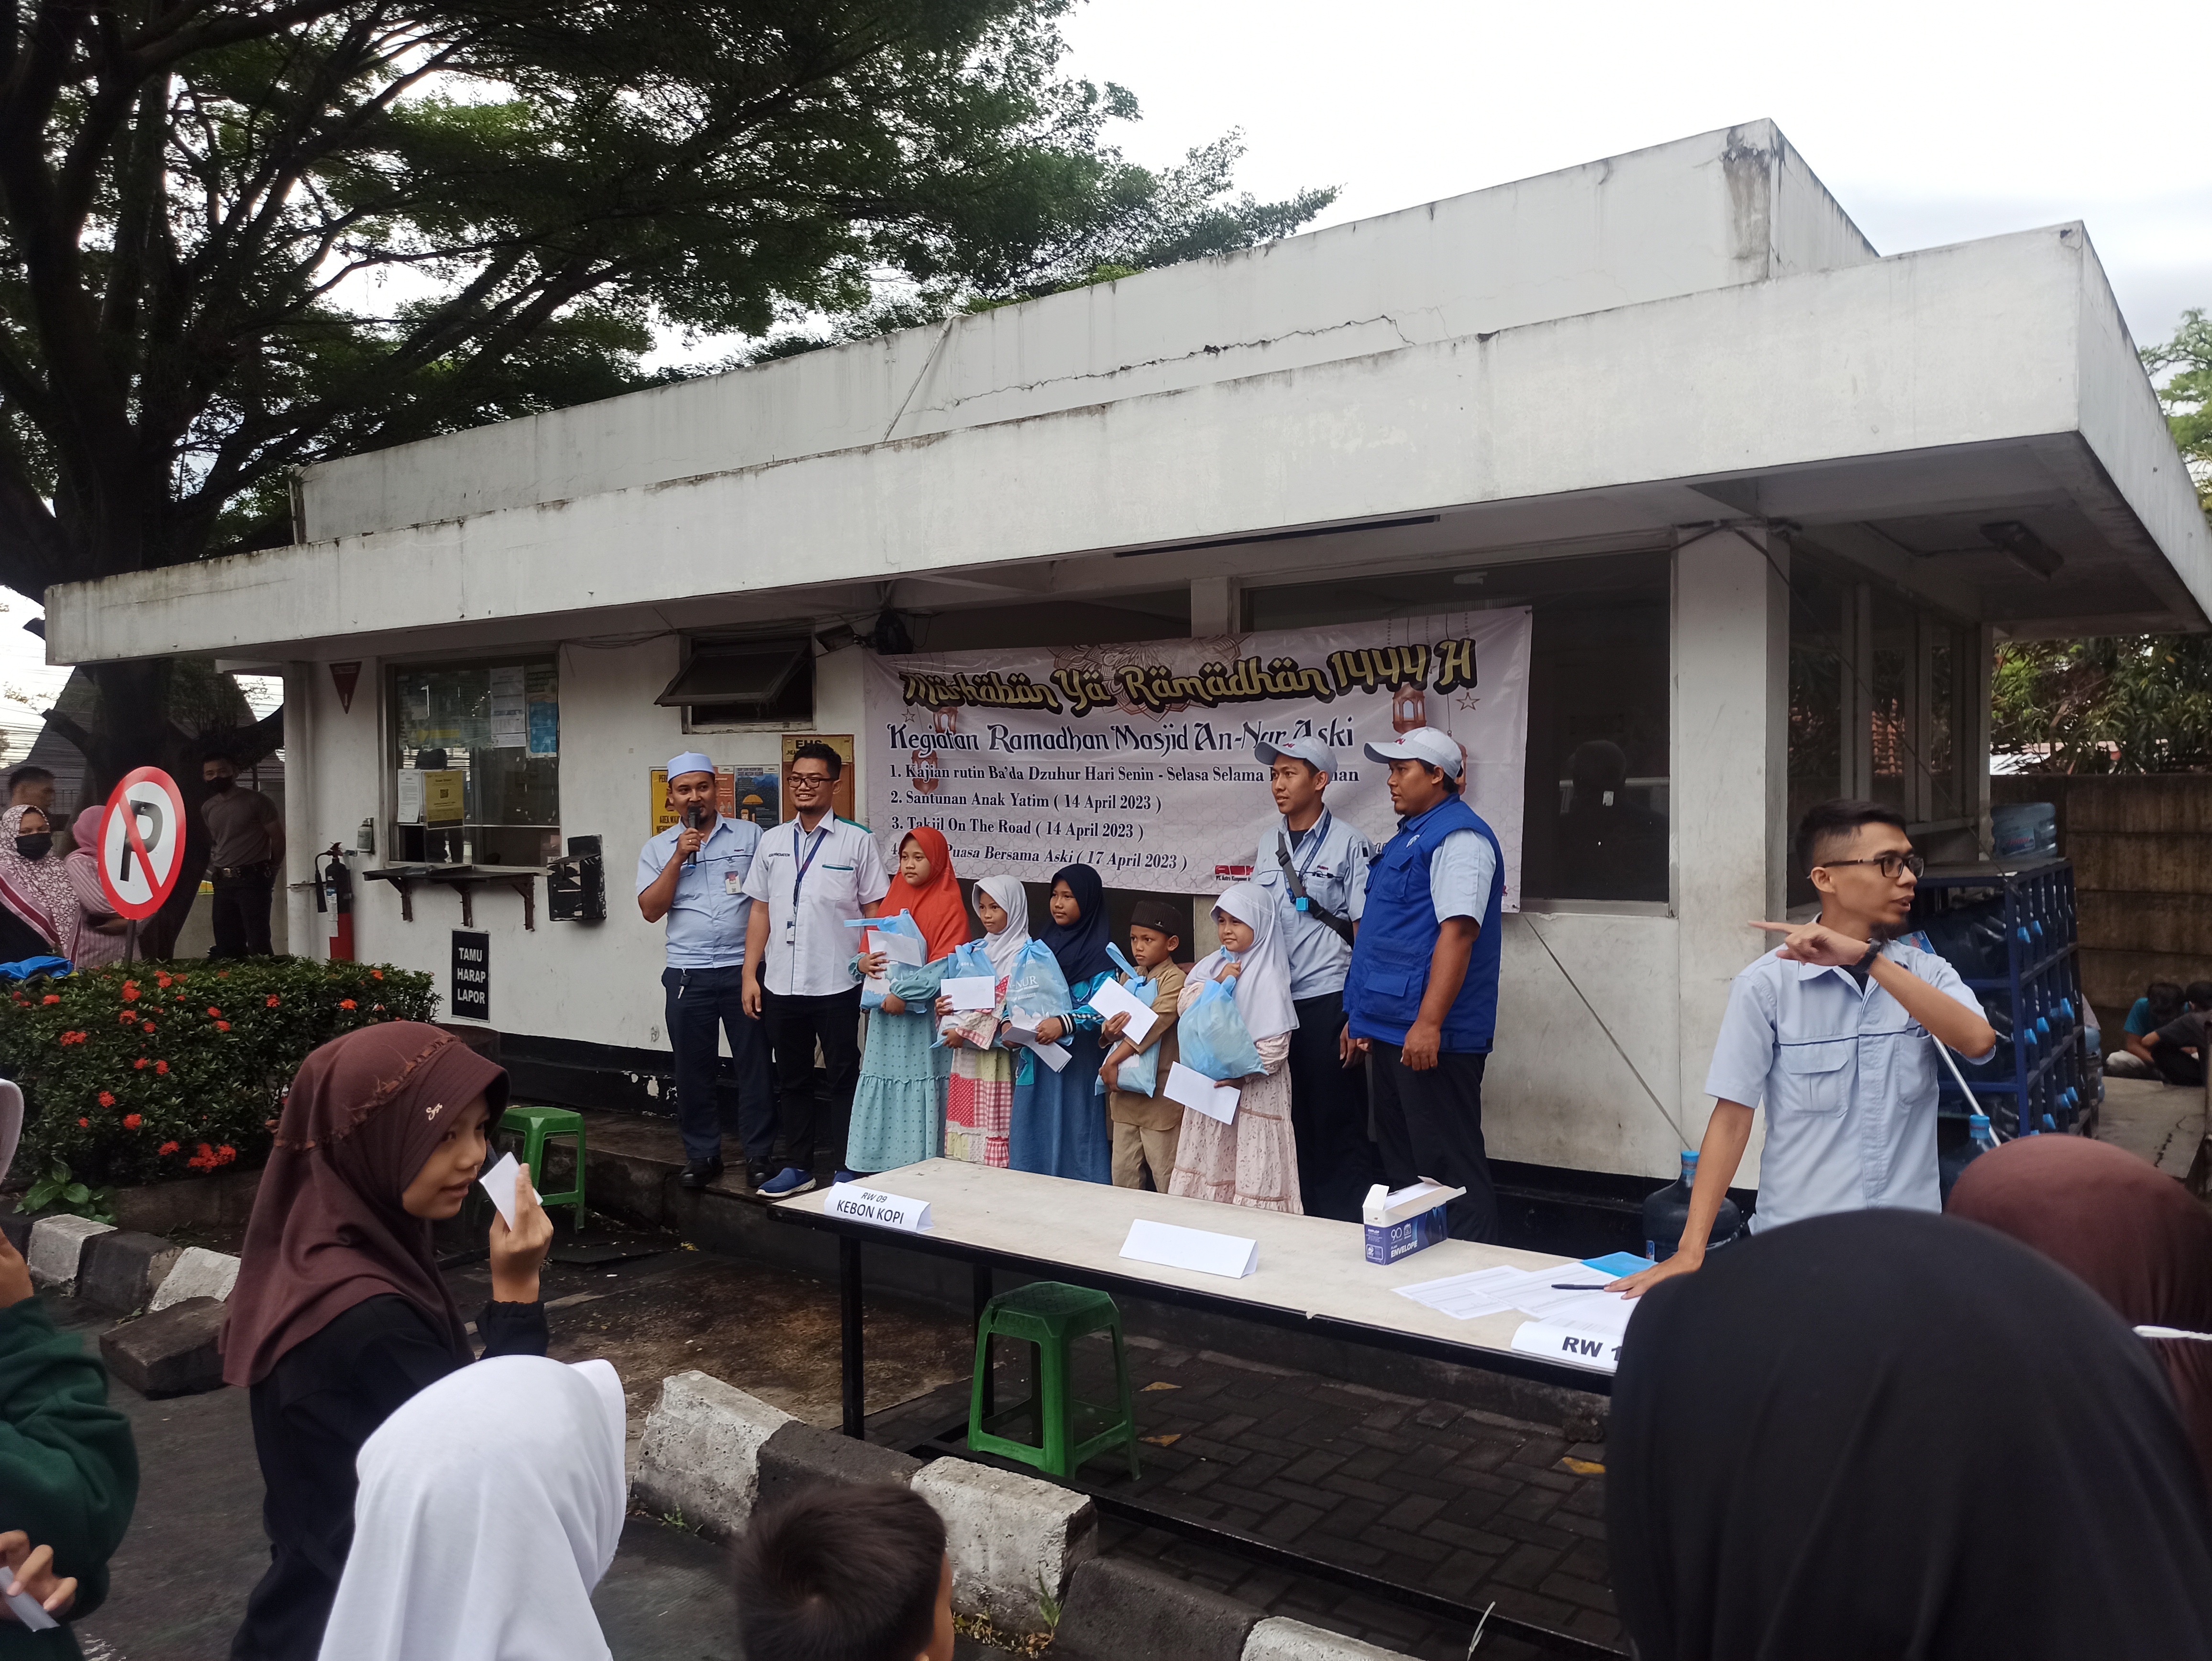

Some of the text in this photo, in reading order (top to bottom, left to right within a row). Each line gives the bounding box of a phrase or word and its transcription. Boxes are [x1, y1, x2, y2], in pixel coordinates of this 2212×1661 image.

[1327, 644, 1431, 696] 1444
[1434, 638, 1477, 694] H
[887, 723, 979, 756] Kegiatan
[987, 724, 1109, 753] Ramadhan
[1110, 722, 1189, 757] Masjid
[1293, 717, 1354, 746] Aski
[890, 764, 901, 777] 1.
[906, 764, 950, 782] Kajian
[953, 765, 984, 778] rutin
[988, 765, 1024, 780] Ba'da
[1029, 766, 1081, 780] Dzuhur
[1084, 766, 1115, 781] Hari
[1118, 766, 1154, 781] Senin
[1167, 766, 1209, 781] Selasa
[1213, 766, 1264, 782] Selama
[891, 790, 902, 803] 2.
[906, 790, 967, 804] Santunan
[971, 792, 1006, 806] Anak
[1010, 793, 1049, 807] Yatim
[1064, 794, 1080, 808] 14
[1084, 795, 1116, 813] April
[1120, 795, 1151, 809] 2023
[891, 816, 903, 829] 3.
[907, 817, 944, 830] Takjil
[948, 818, 965, 831] On
[970, 819, 995, 832] The
[998, 819, 1031, 834] Road
[1046, 821, 1061, 835] 14
[1065, 822, 1098, 841] April
[1102, 823, 1134, 838] 2023
[120, 799, 164, 882] P
[984, 846, 1040, 862] Bersama
[1043, 849, 1073, 863] Aski
[1088, 850, 1105, 864] 17
[1106, 852, 1141, 871] April
[1145, 853, 1177, 869] 2023
[458, 947, 482, 962] TAMU
[457, 967, 486, 984] HARAP
[1008, 975, 1038, 989] N-NUR
[457, 988, 485, 1004] LAPOR
[861, 1192, 888, 1203] RW 09
[837, 1199, 905, 1225] KEBON KOPI
[1391, 1227, 1403, 1241] 90
[1391, 1240, 1417, 1258] ENVELOPE
[1562, 1336, 1604, 1358] RW
